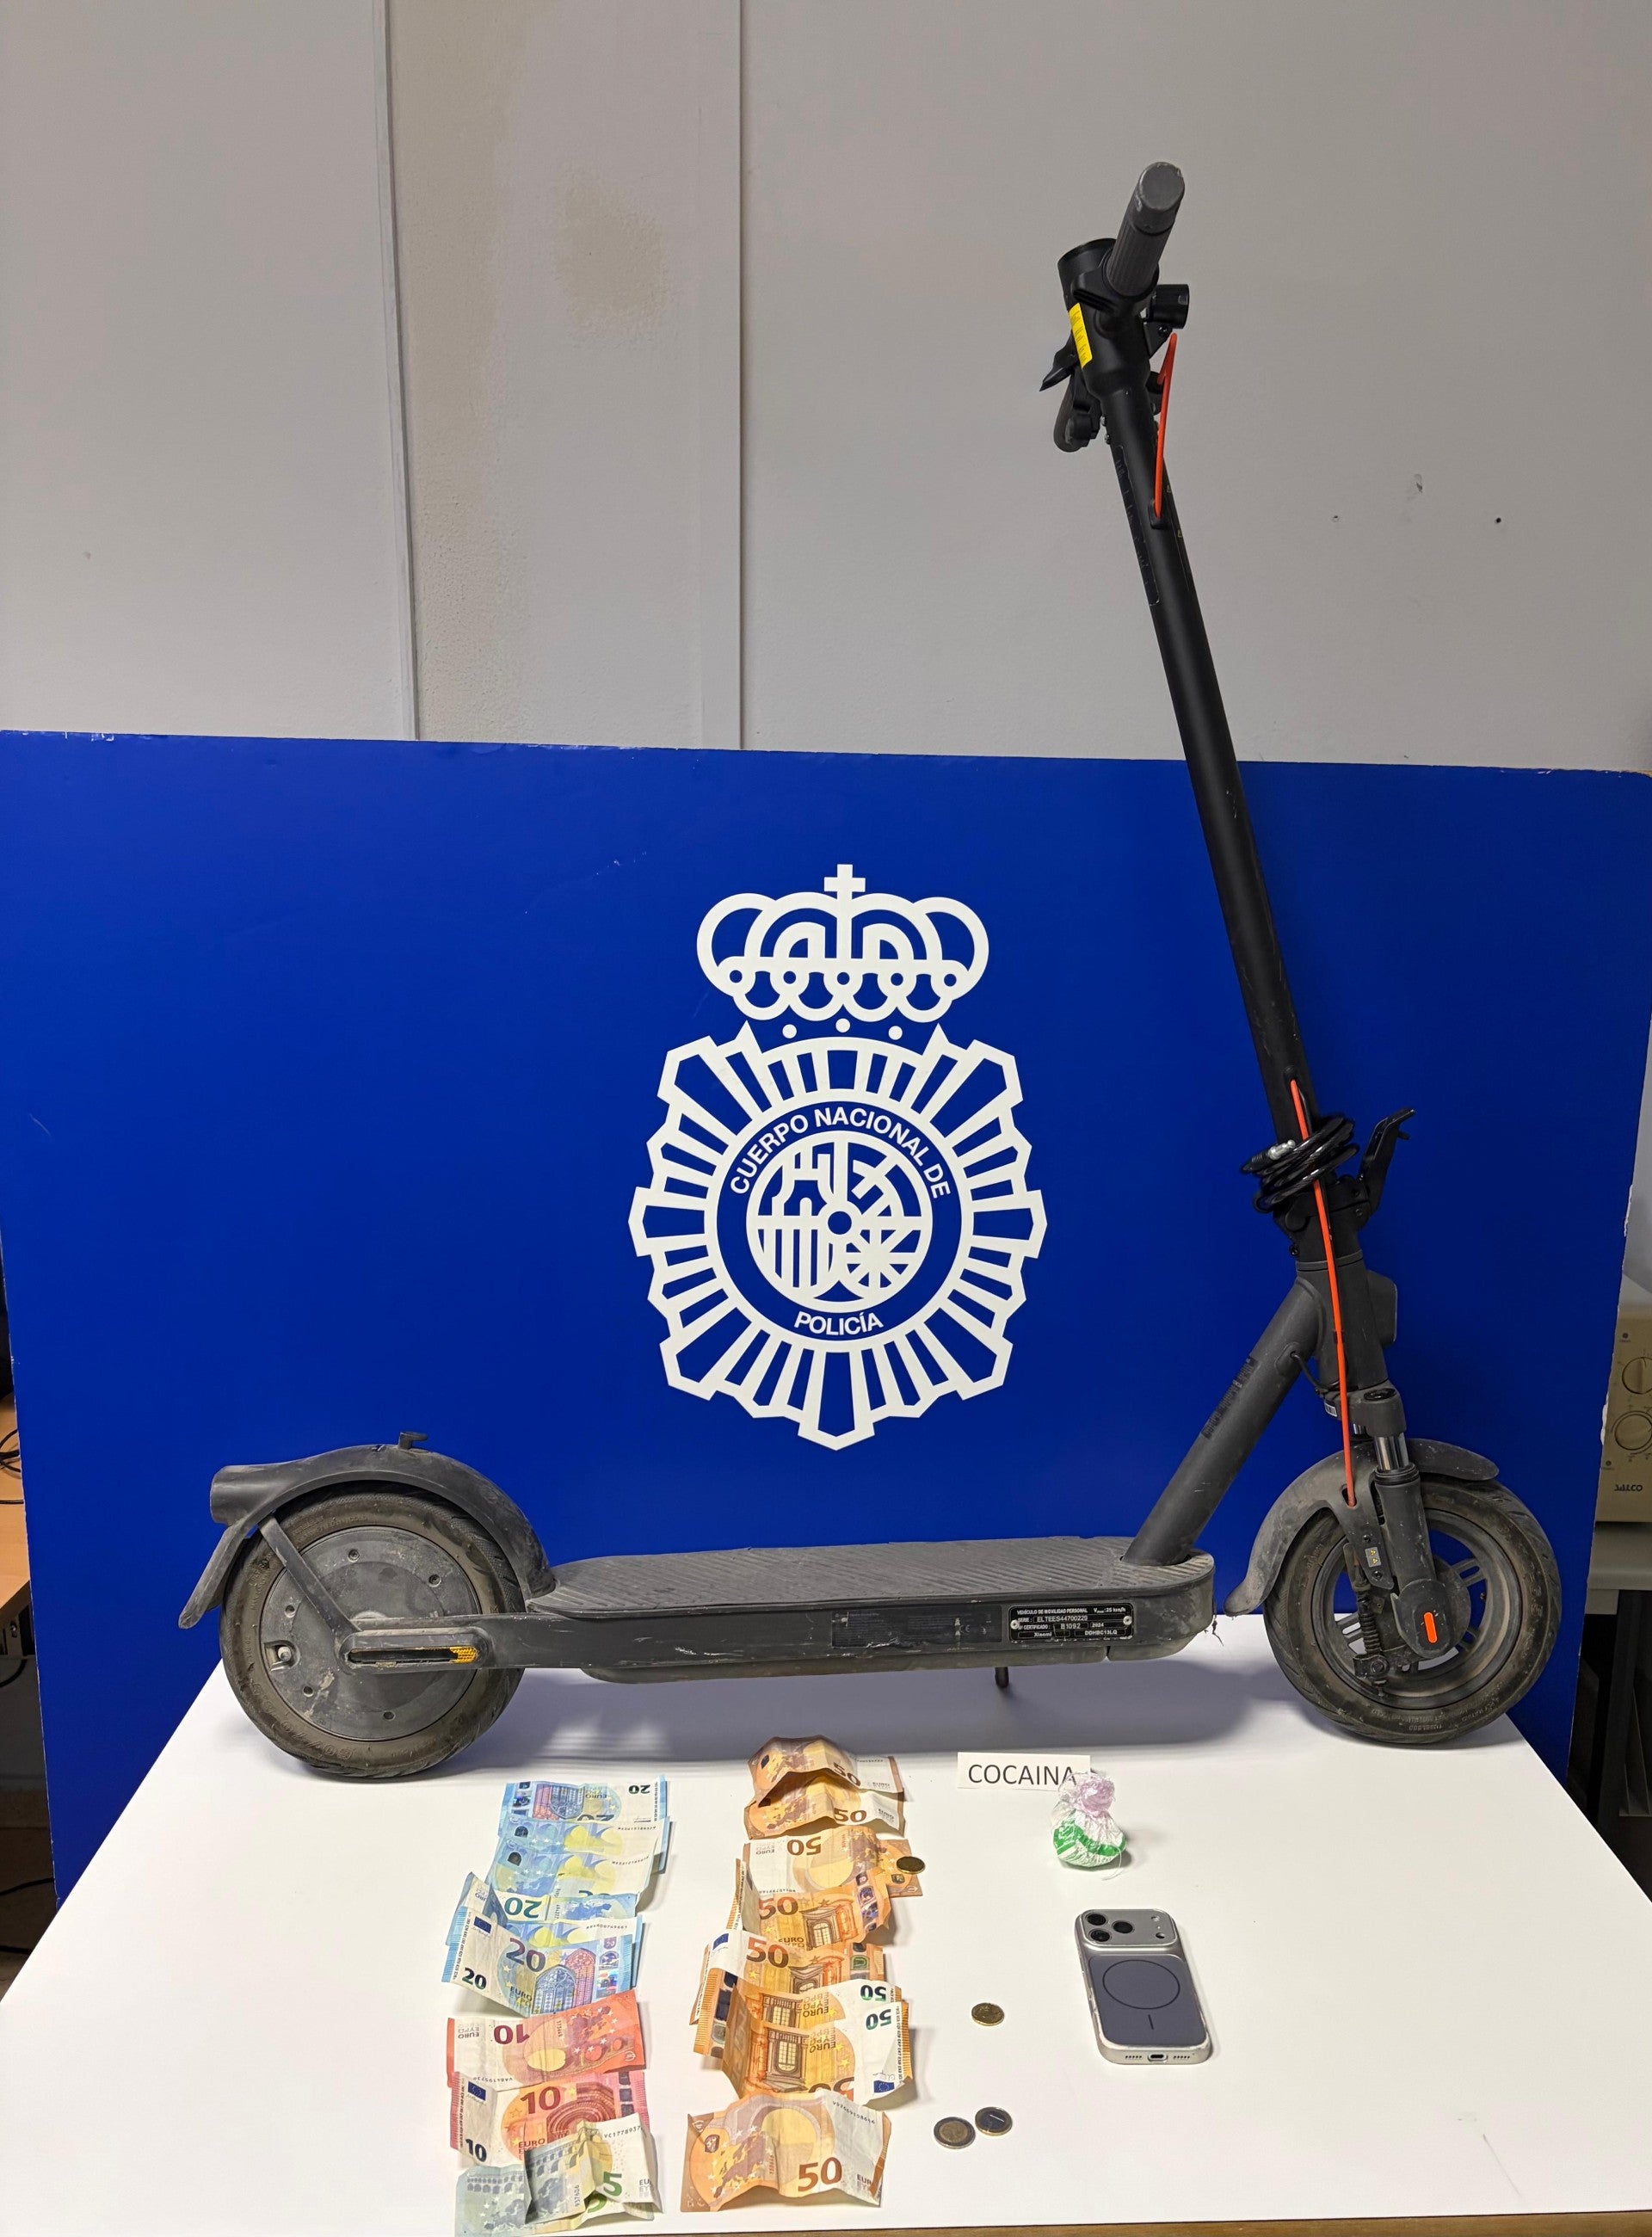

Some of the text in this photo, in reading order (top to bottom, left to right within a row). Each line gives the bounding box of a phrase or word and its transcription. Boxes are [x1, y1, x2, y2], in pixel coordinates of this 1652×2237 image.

[730, 1106, 951, 1199] CUERPO NACIONAL DE
[794, 1310, 884, 1335] POLICÍA
[834, 1762, 860, 1786] 50
[968, 1764, 1076, 1785] COCAINA
[628, 1784, 650, 1794] 20
[834, 1808, 866, 1822] 50
[786, 1836, 822, 1856] 50
[504, 1896, 542, 1919] 20
[758, 1896, 798, 1920] 50
[506, 1937, 546, 1972] 20
[746, 1937, 789, 1968] 50
[462, 1967, 487, 1989] 20
[510, 1986, 533, 2001] EURO
[860, 1985, 886, 2002] 50
[803, 2006, 829, 2018] EURO
[866, 2008, 891, 2031] 50
[493, 2024, 530, 2044] 10
[809, 2041, 836, 2054] EURO
[520, 2086, 561, 2114] 10
[465, 2138, 487, 2162] 10
[518, 2138, 546, 2148] EURO
[603, 2171, 623, 2197] 5
[798, 2157, 842, 2192] 50
